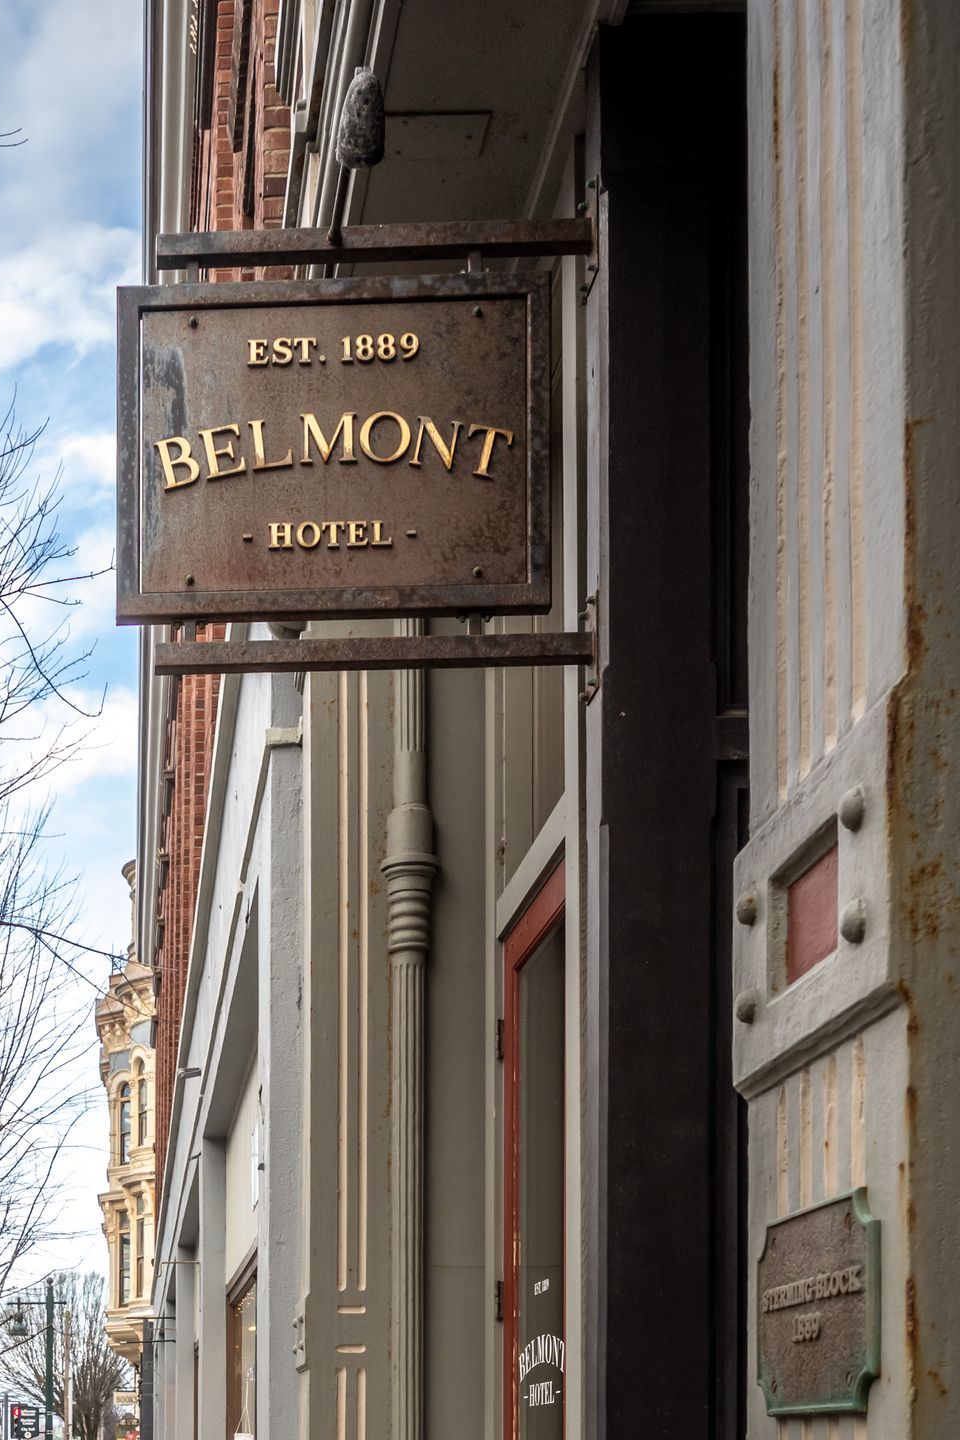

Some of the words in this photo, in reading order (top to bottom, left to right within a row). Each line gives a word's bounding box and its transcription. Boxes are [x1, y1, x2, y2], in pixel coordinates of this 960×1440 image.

[247, 337, 326, 368] EST.
[340, 332, 419, 364] 1889
[154, 411, 515, 492] BELMONT
[268, 520, 393, 551] HOTEL
[816, 1265, 862, 1300] BLOCK
[792, 1311, 821, 1343] 1889
[519, 1333, 564, 1384] BELMONT
[529, 1381, 554, 1407] HOTEL
